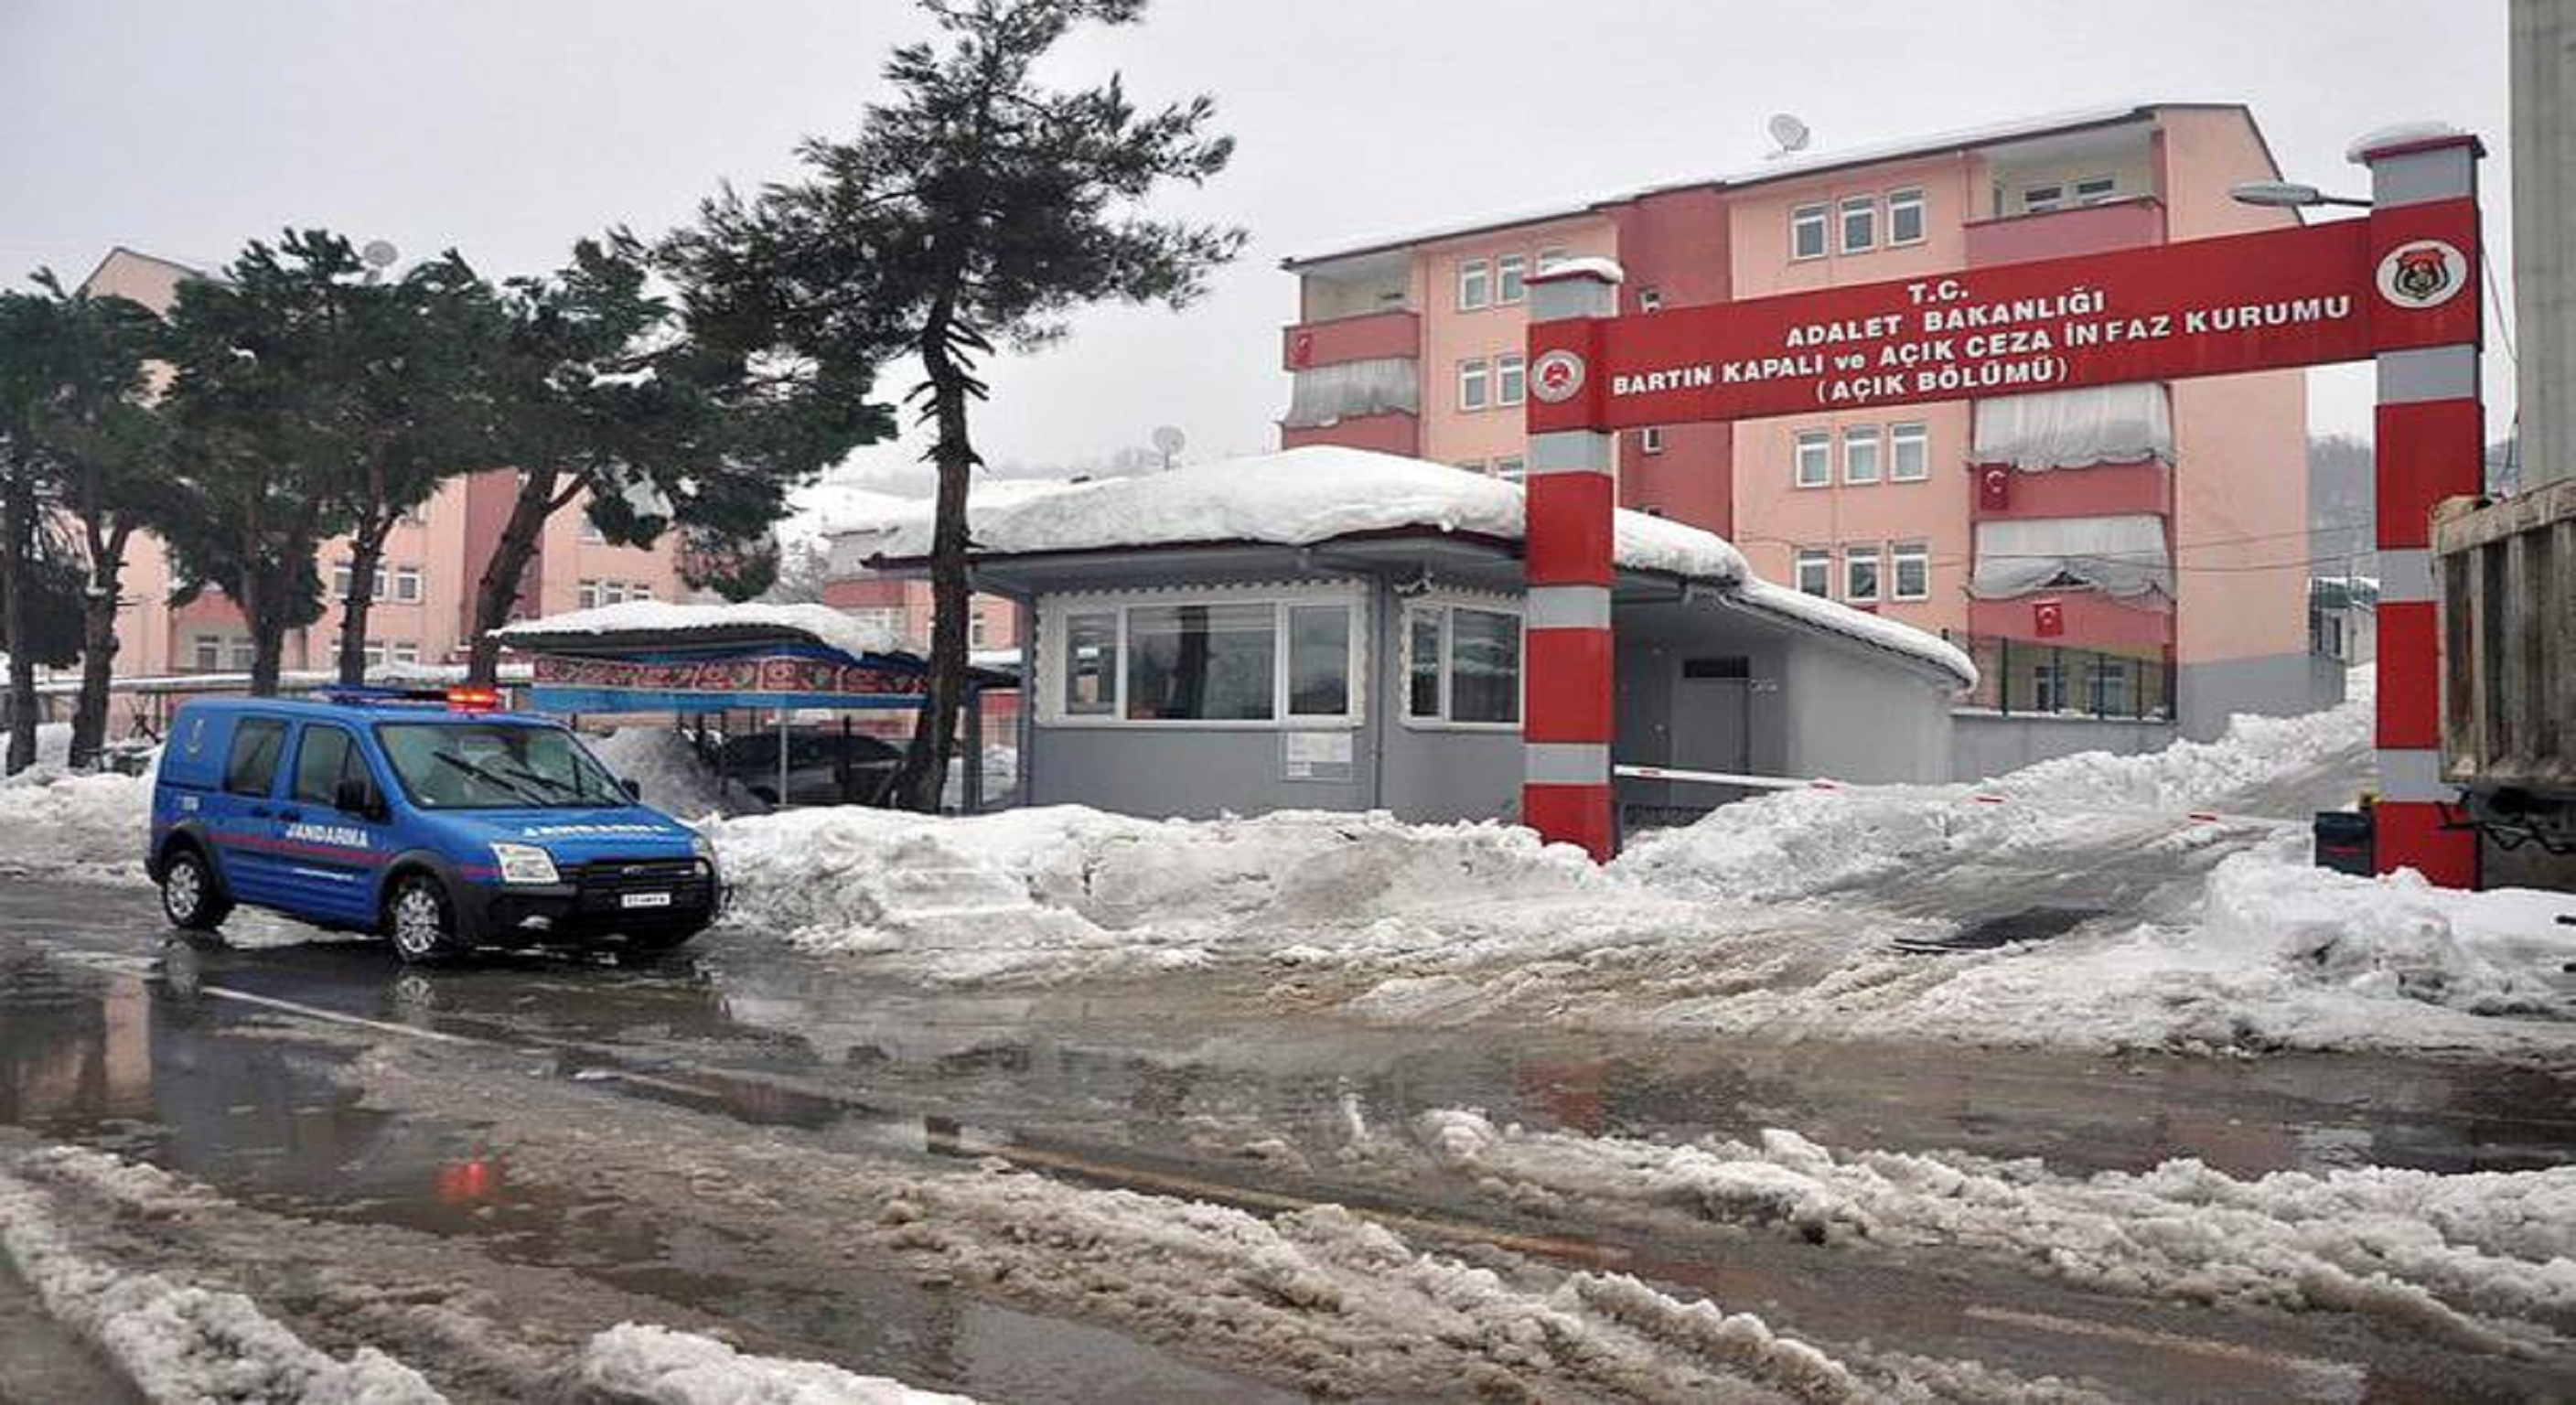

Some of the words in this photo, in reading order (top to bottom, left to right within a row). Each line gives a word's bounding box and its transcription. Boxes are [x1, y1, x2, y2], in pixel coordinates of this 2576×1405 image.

[1908, 280, 1970, 304] T.C.
[1787, 315, 1902, 347] ADALET
[1924, 286, 2106, 331] BAKANLIĞI
[1613, 364, 1712, 395] BARTIN
[1723, 354, 1823, 382] KAPALI
[1834, 353, 1865, 370] ve
[1880, 339, 1955, 369] AÇIK
[1967, 329, 2052, 359] CEZA
[2184, 295, 2350, 334] KURUMU
[1817, 373, 1905, 403] (AÇIK
[1917, 357, 2069, 392] BÖLÜMÜ)
[285, 823, 368, 848] JANDARMA
